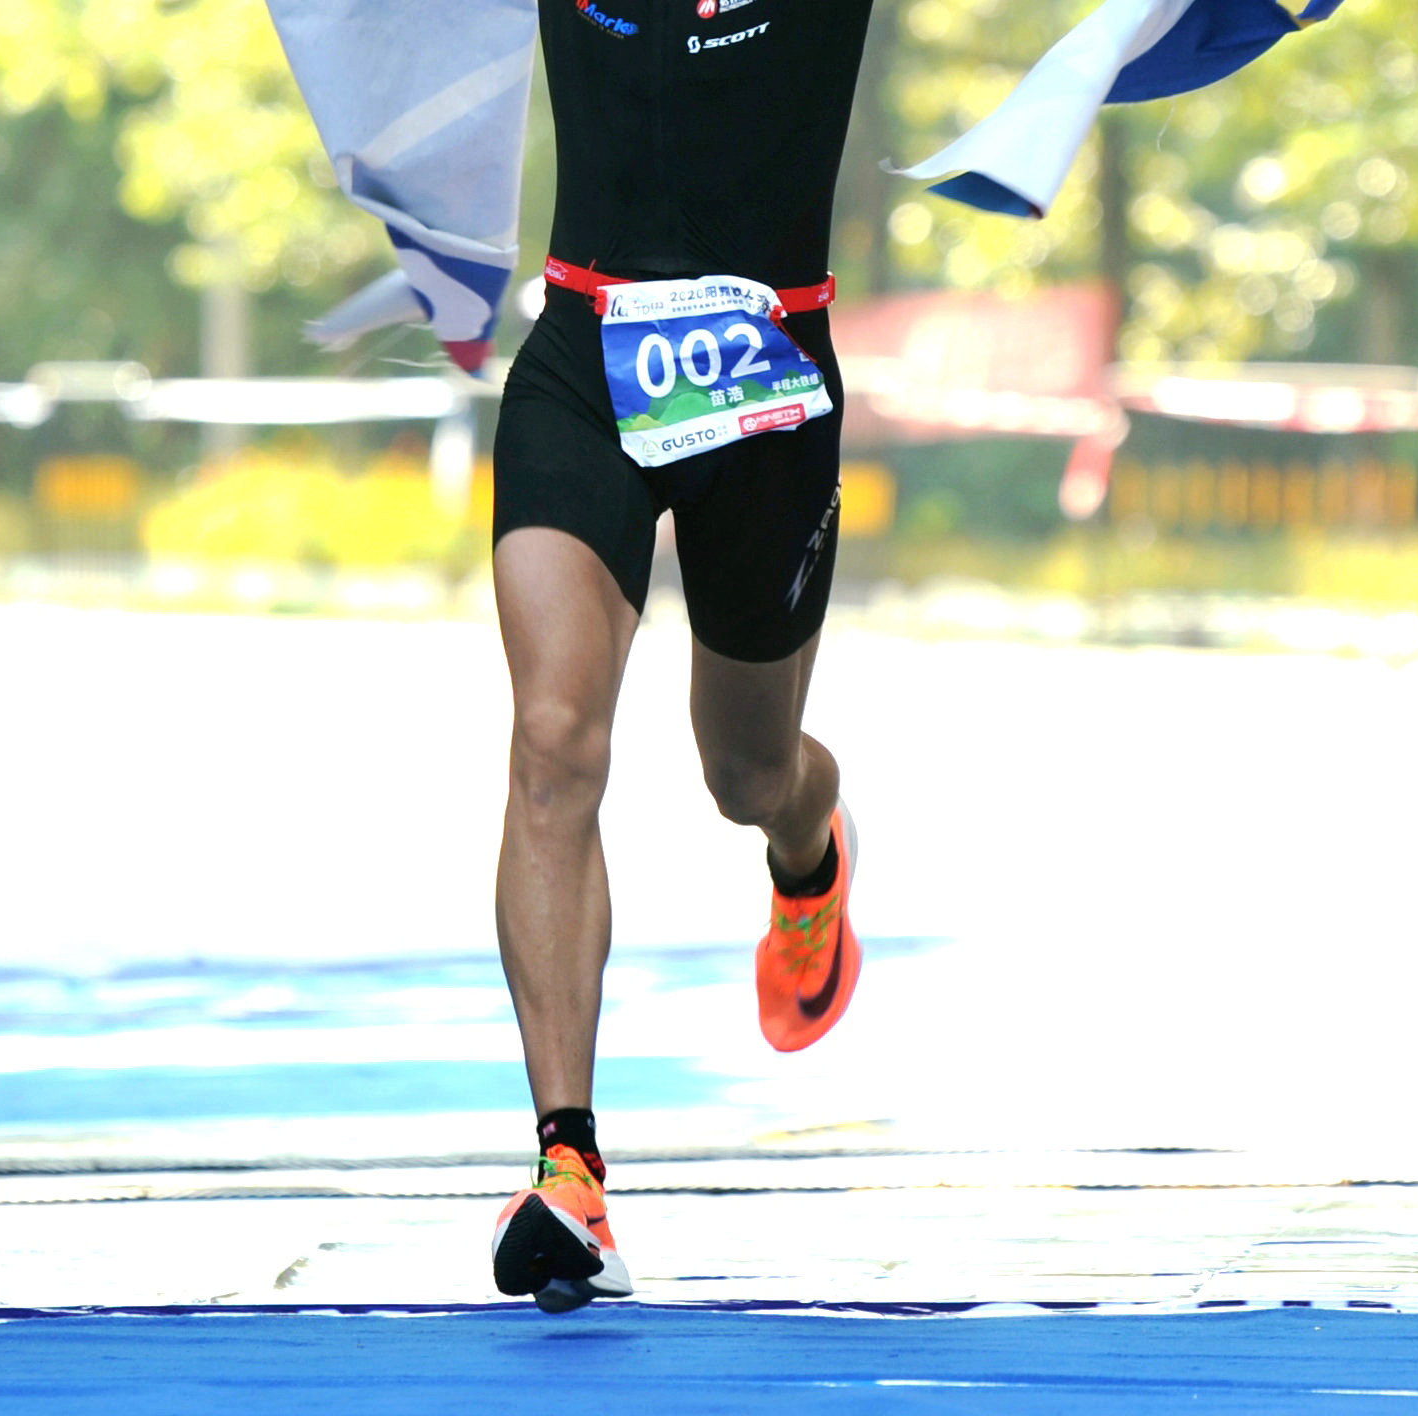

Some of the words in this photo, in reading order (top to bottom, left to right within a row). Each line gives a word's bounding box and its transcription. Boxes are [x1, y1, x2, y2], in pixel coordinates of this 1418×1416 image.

[702, 21, 770, 49] SCOTT
[636, 322, 772, 399] 002
[708, 385, 745, 407] 苗浩
[661, 428, 716, 452] GUSTO
